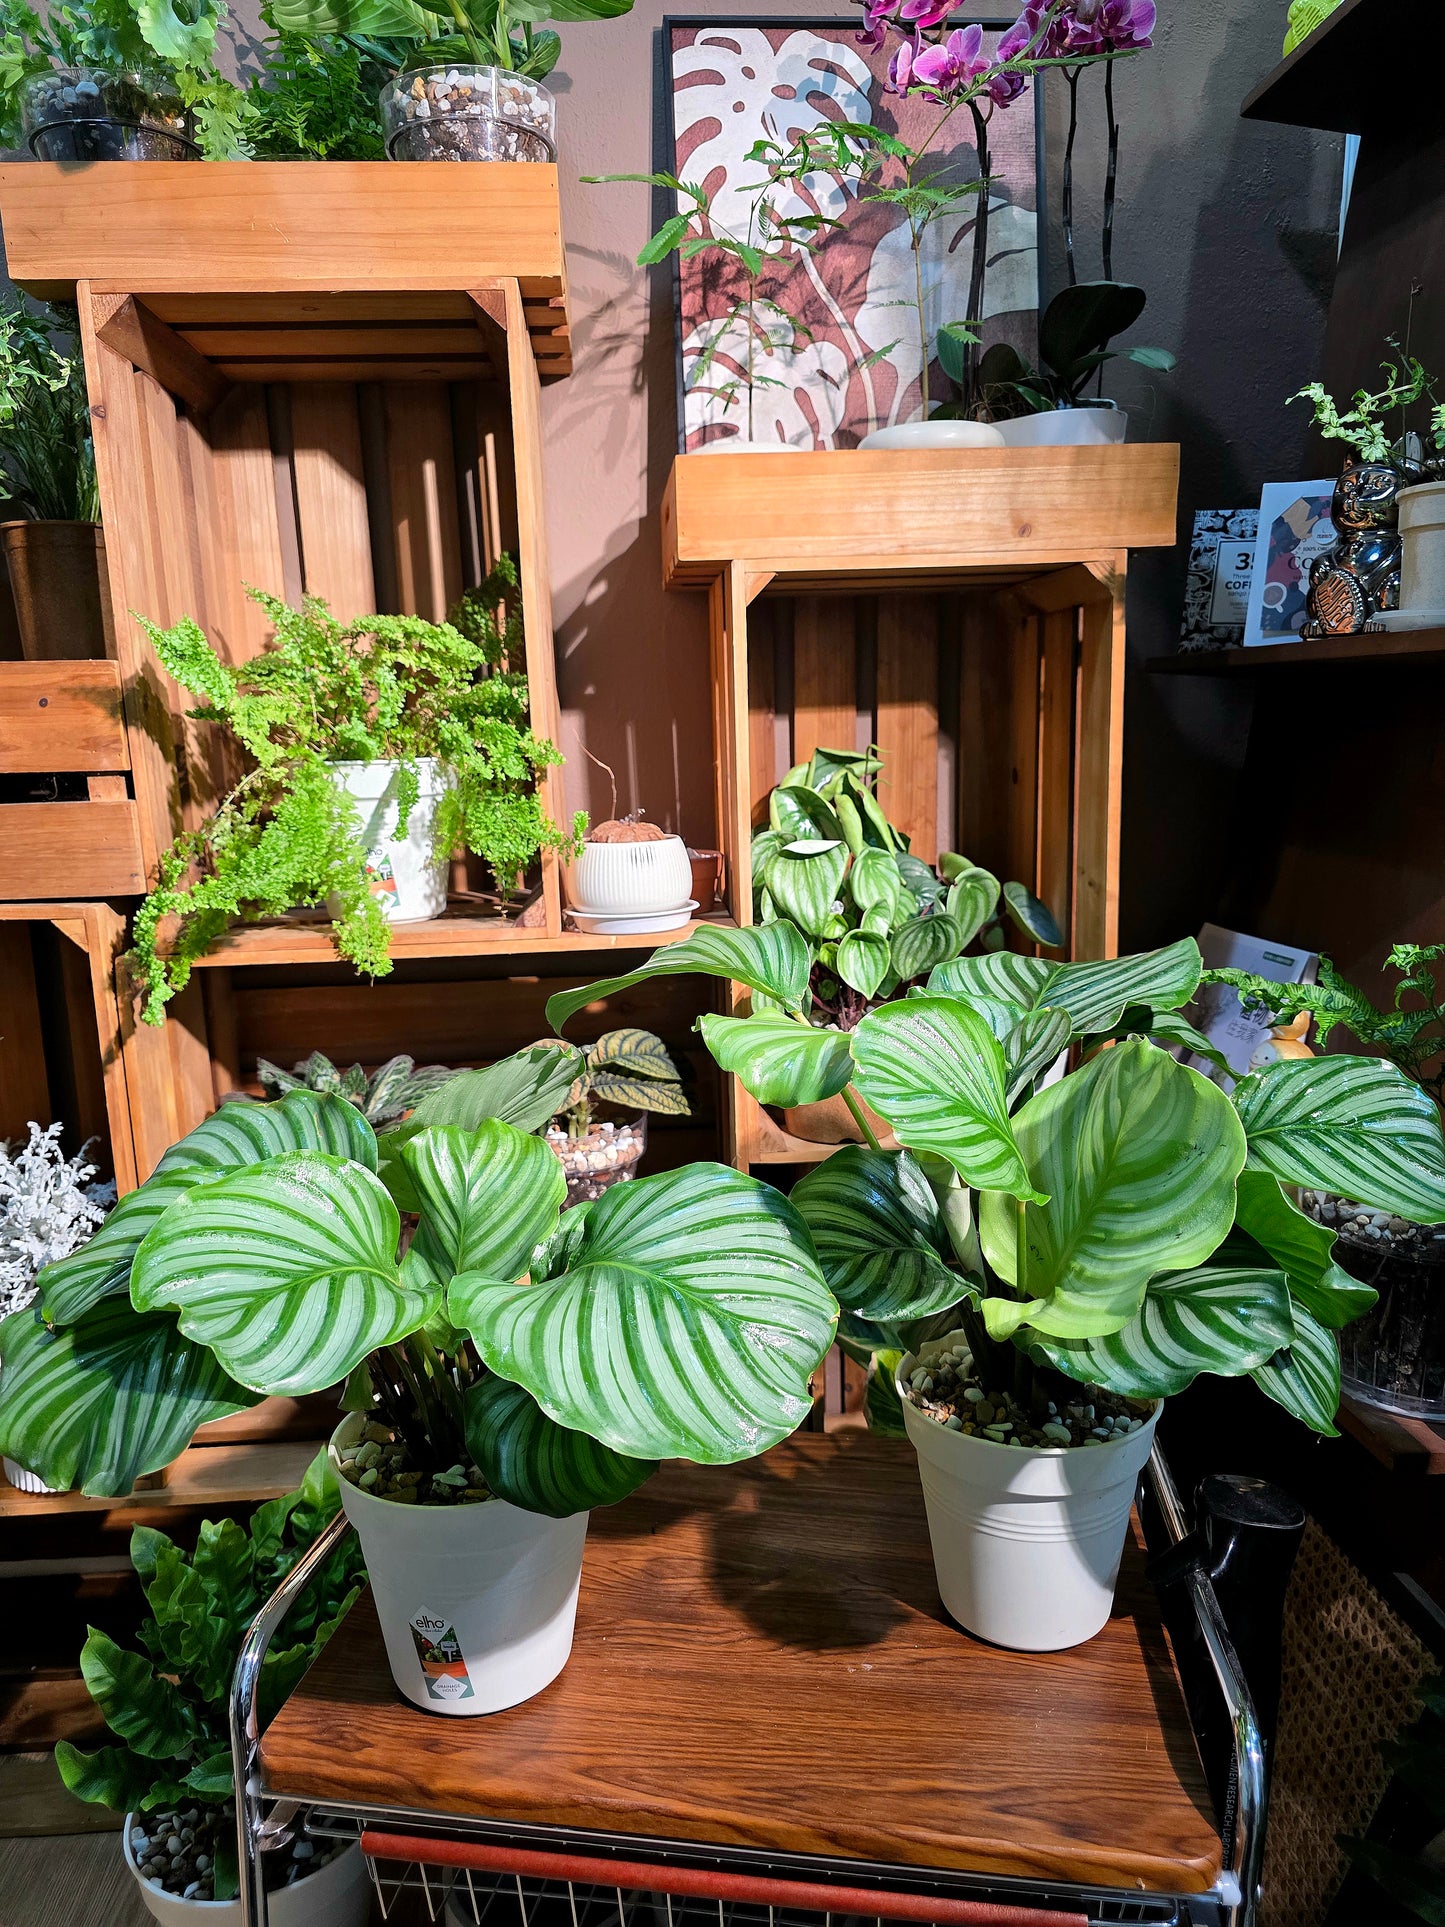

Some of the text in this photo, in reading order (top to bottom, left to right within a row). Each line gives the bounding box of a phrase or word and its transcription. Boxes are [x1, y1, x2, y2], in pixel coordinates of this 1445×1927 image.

[1235, 552, 1255, 570] 3
[366, 847, 383, 856] lho
[415, 1616, 445, 1628] elho
[1223, 1785, 1237, 1828] RESEARCH
